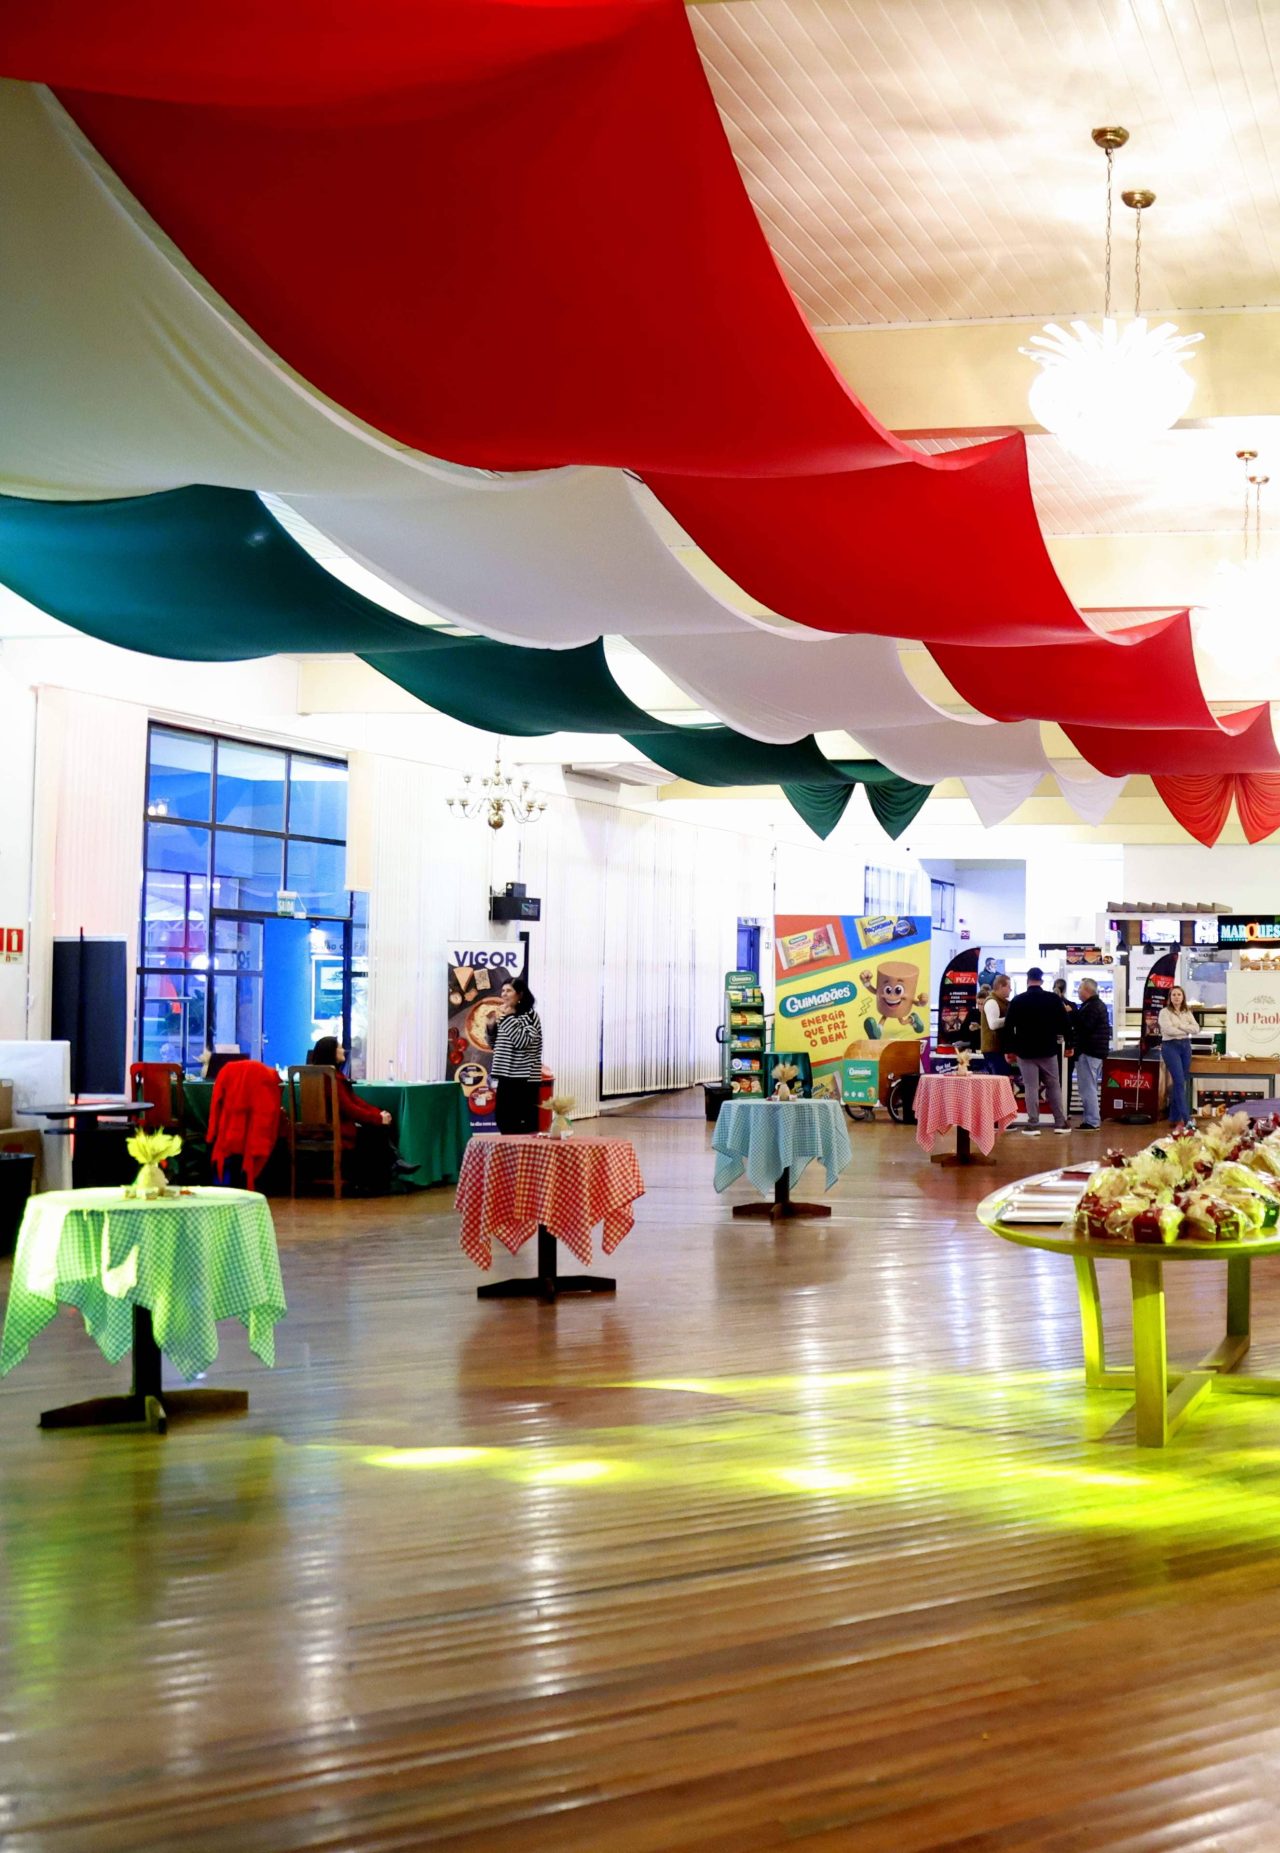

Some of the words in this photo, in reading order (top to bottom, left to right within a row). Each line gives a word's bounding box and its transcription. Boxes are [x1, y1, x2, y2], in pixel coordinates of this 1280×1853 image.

[454, 950, 518, 968] VIGOR
[1236, 1012, 1249, 1024] Di
[804, 1028, 825, 1039] QUE
[827, 1021, 848, 1033] FAZ
[810, 1039, 818, 1048] O
[820, 1031, 848, 1045] BEM!
[1124, 1079, 1151, 1089] PIZZA
